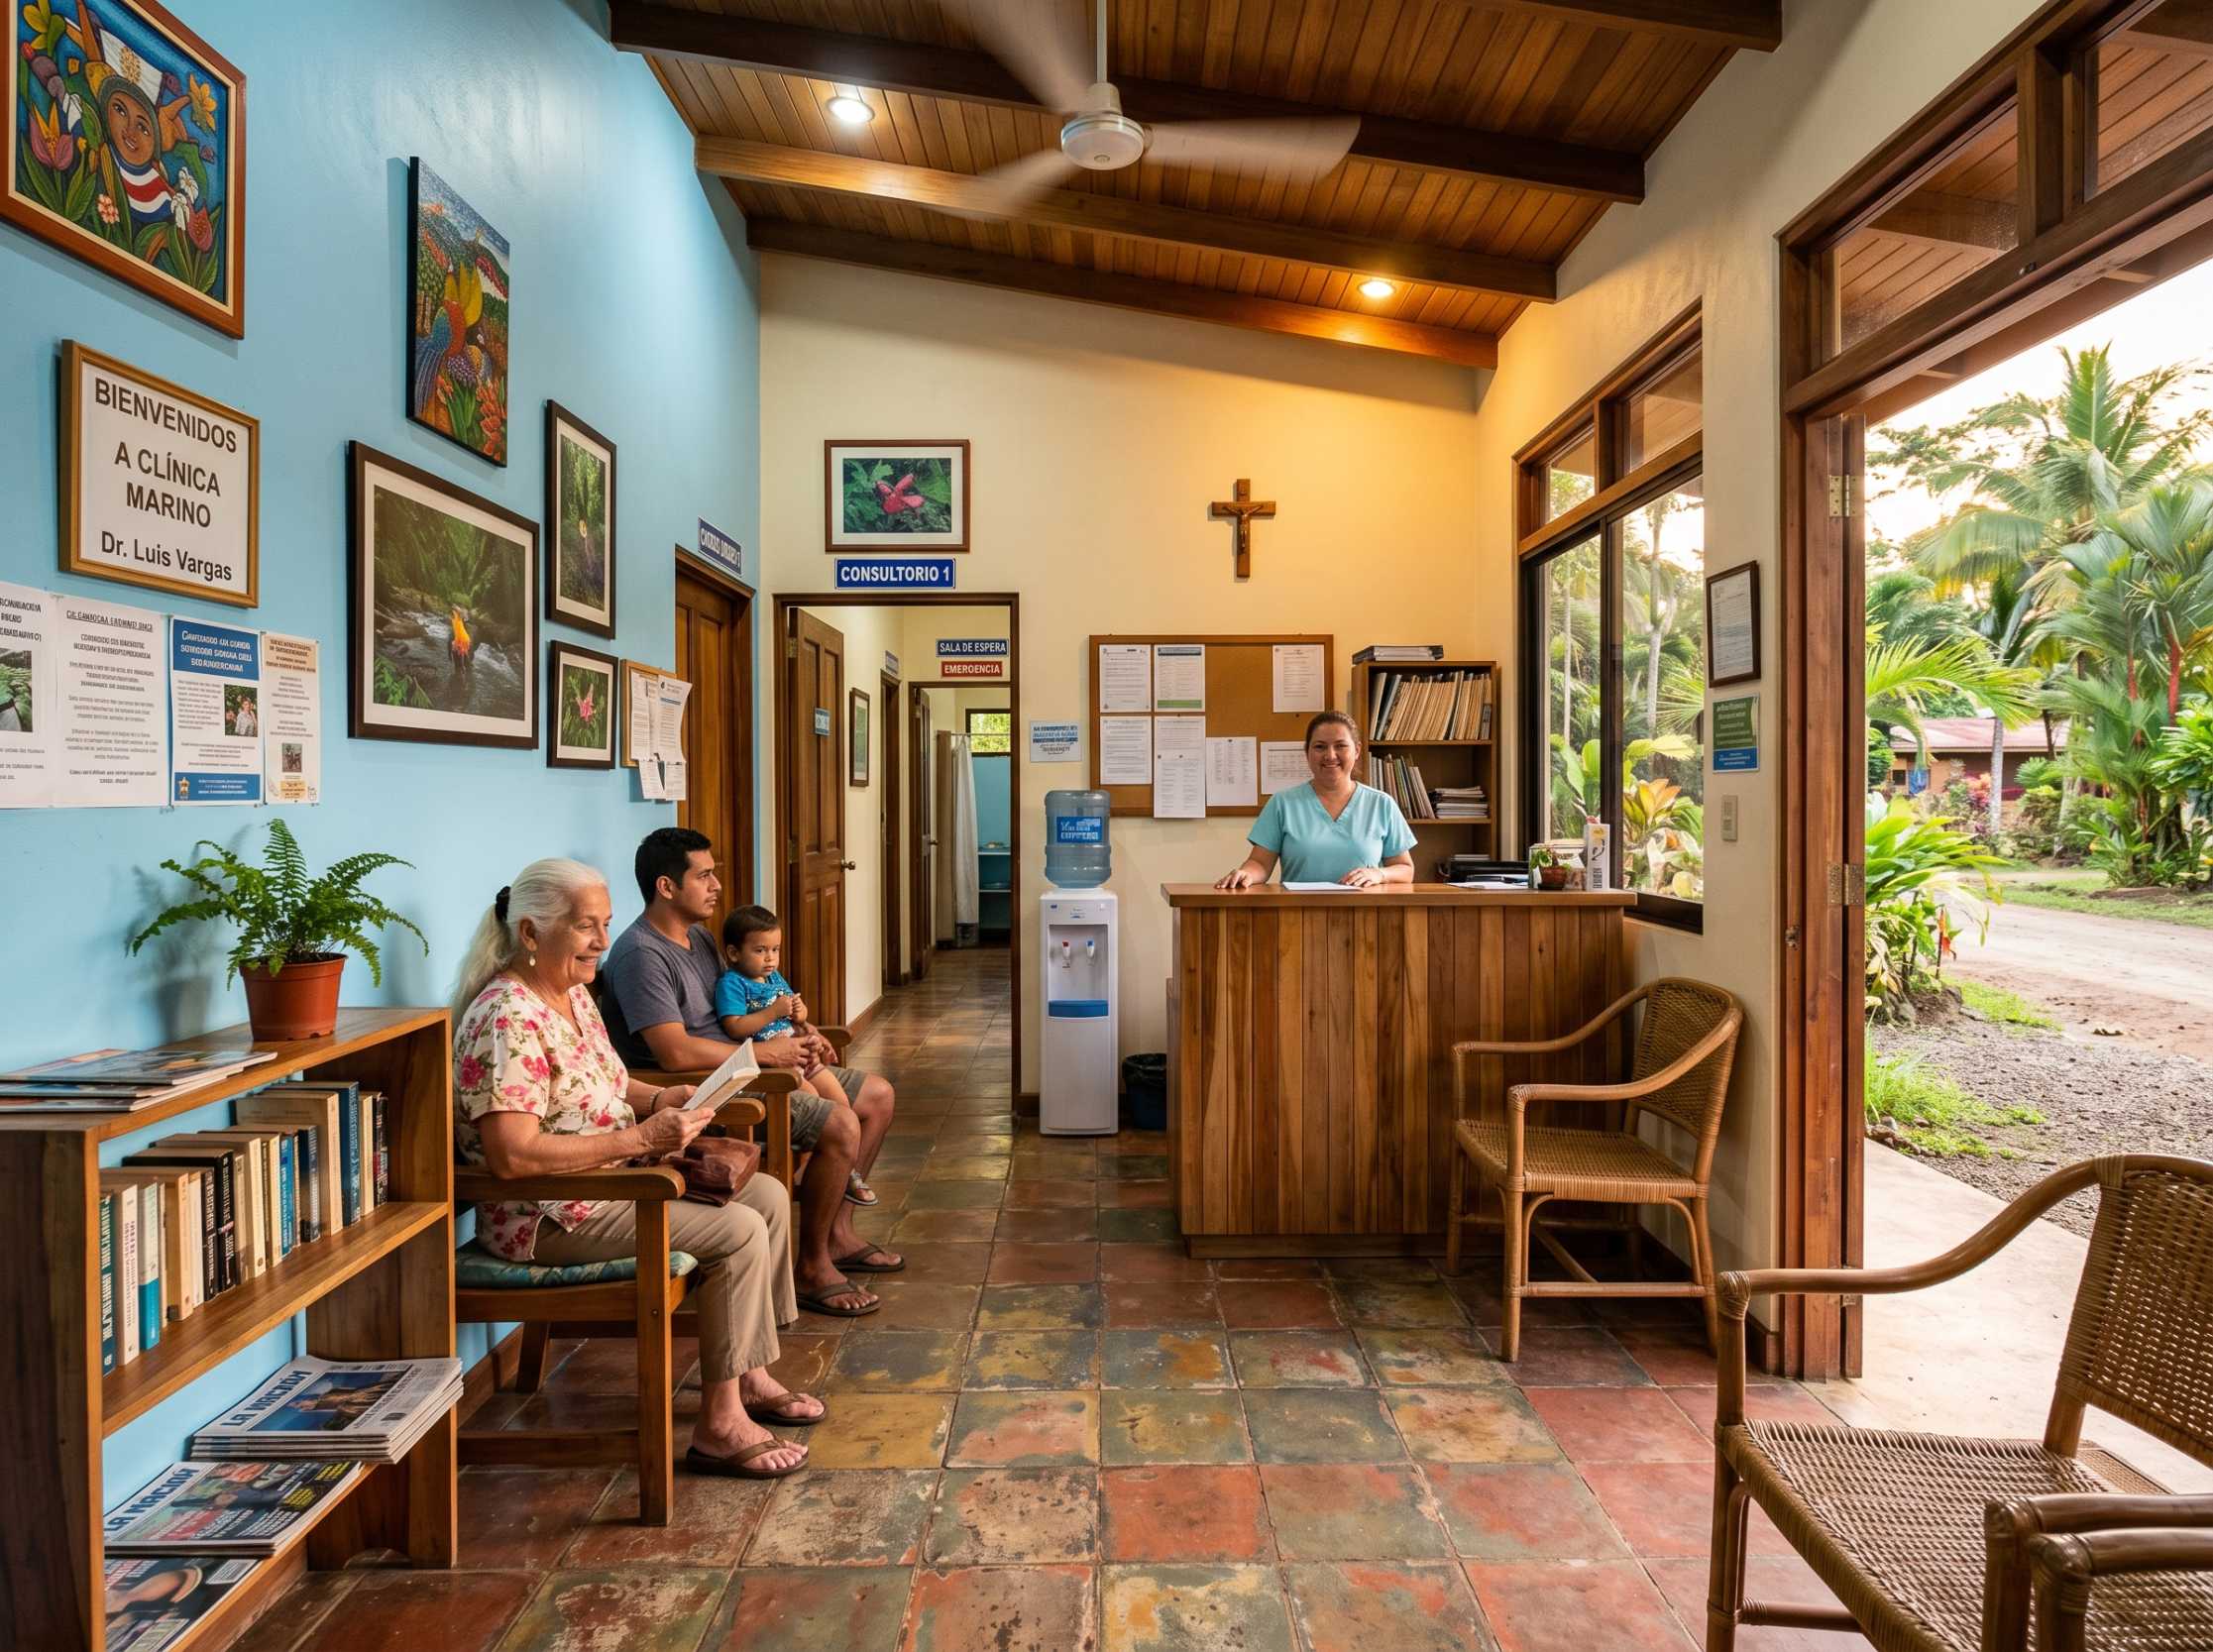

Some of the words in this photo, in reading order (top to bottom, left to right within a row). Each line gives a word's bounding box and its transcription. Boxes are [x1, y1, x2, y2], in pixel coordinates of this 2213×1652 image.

[94, 377, 237, 454] BIENVENIDOS
[114, 441, 132, 469] A
[138, 451, 221, 497] CLÍNICA
[126, 482, 211, 528] MARINO
[101, 530, 127, 558] Dr.
[134, 538, 170, 568] Luis
[176, 548, 233, 583] Vargas
[840, 566, 940, 582] CONSULTORIO
[942, 566, 949, 582] 1
[940, 642, 961, 653] SALA
[962, 642, 973, 653] DE
[974, 642, 1006, 653] ESPERA
